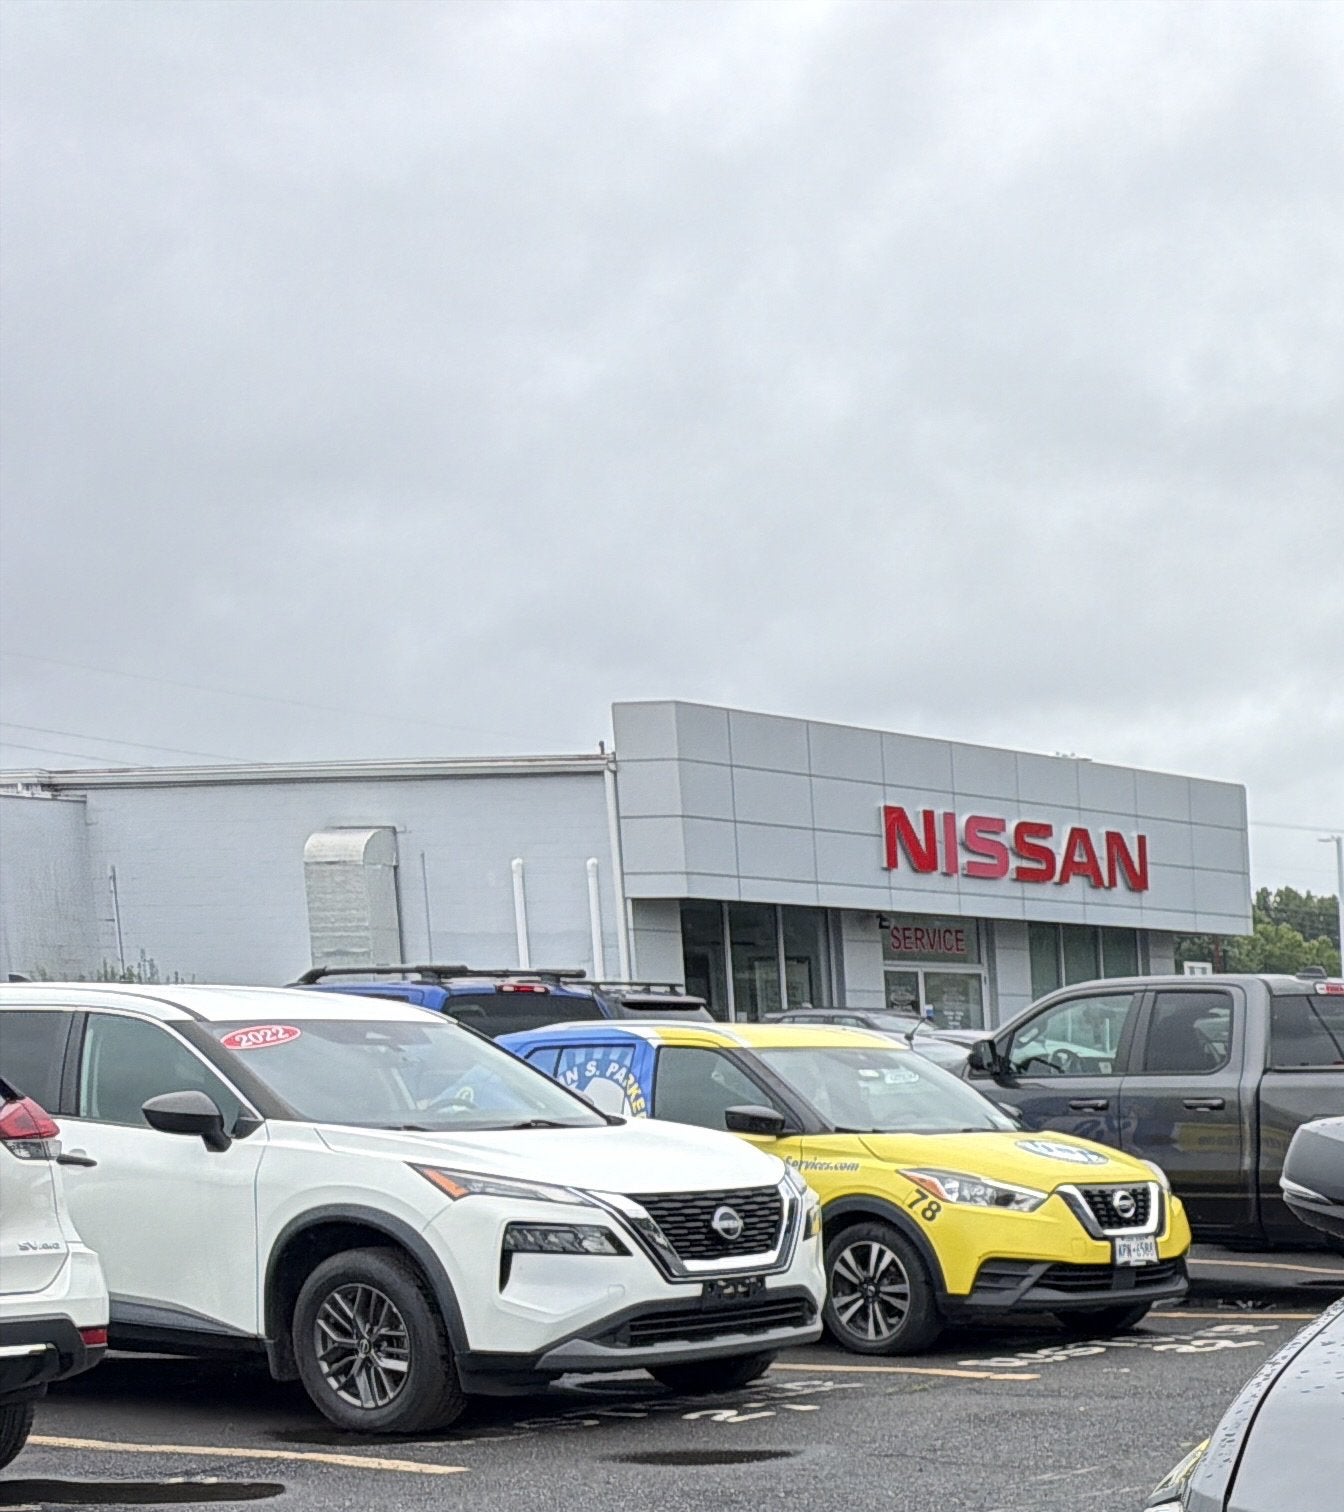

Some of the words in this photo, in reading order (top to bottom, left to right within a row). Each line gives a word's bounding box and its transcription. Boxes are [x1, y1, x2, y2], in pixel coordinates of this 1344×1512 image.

[881, 804, 1149, 893] NISSAN
[891, 926, 966, 954] SERVICE
[234, 1025, 290, 1047] 2022
[907, 1188, 942, 1222] 78
